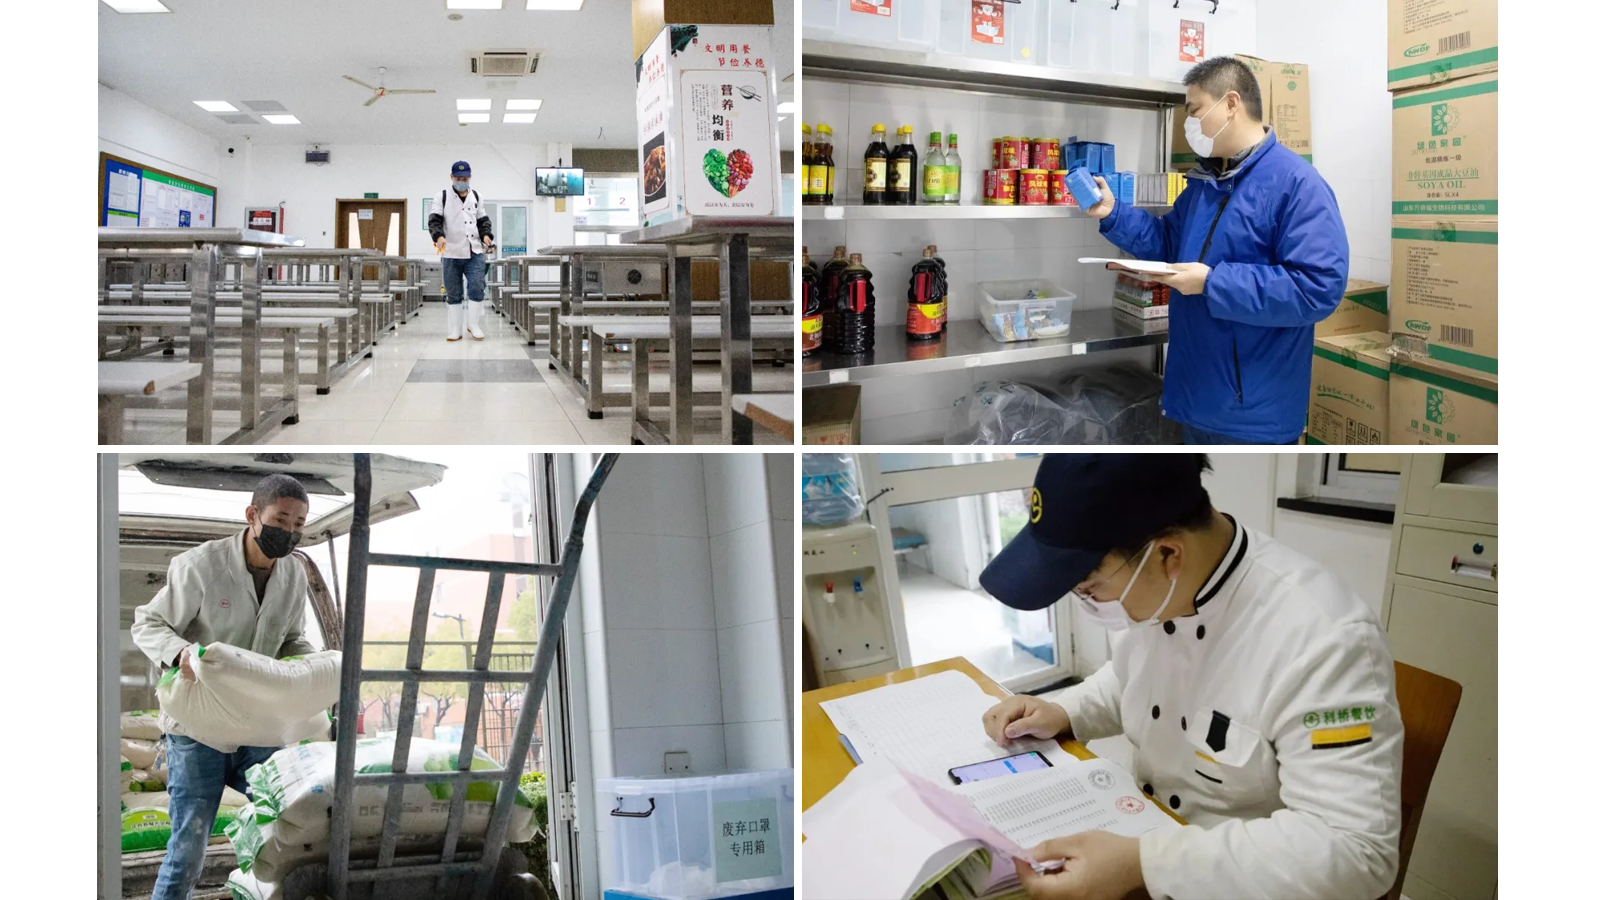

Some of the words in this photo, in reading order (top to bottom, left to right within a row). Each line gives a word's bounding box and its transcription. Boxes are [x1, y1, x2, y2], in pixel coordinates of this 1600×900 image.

[704, 43, 751, 54] 文明用餐
[721, 84, 733, 111] 营养
[712, 114, 724, 141] 均衡
[1417, 181, 1445, 190] SOYA
[1446, 180, 1467, 189] OIL
[1323, 705, 1377, 725] 科桥餐饮
[722, 817, 771, 838] 废弃口罩
[730, 839, 766, 857] 专用箱
